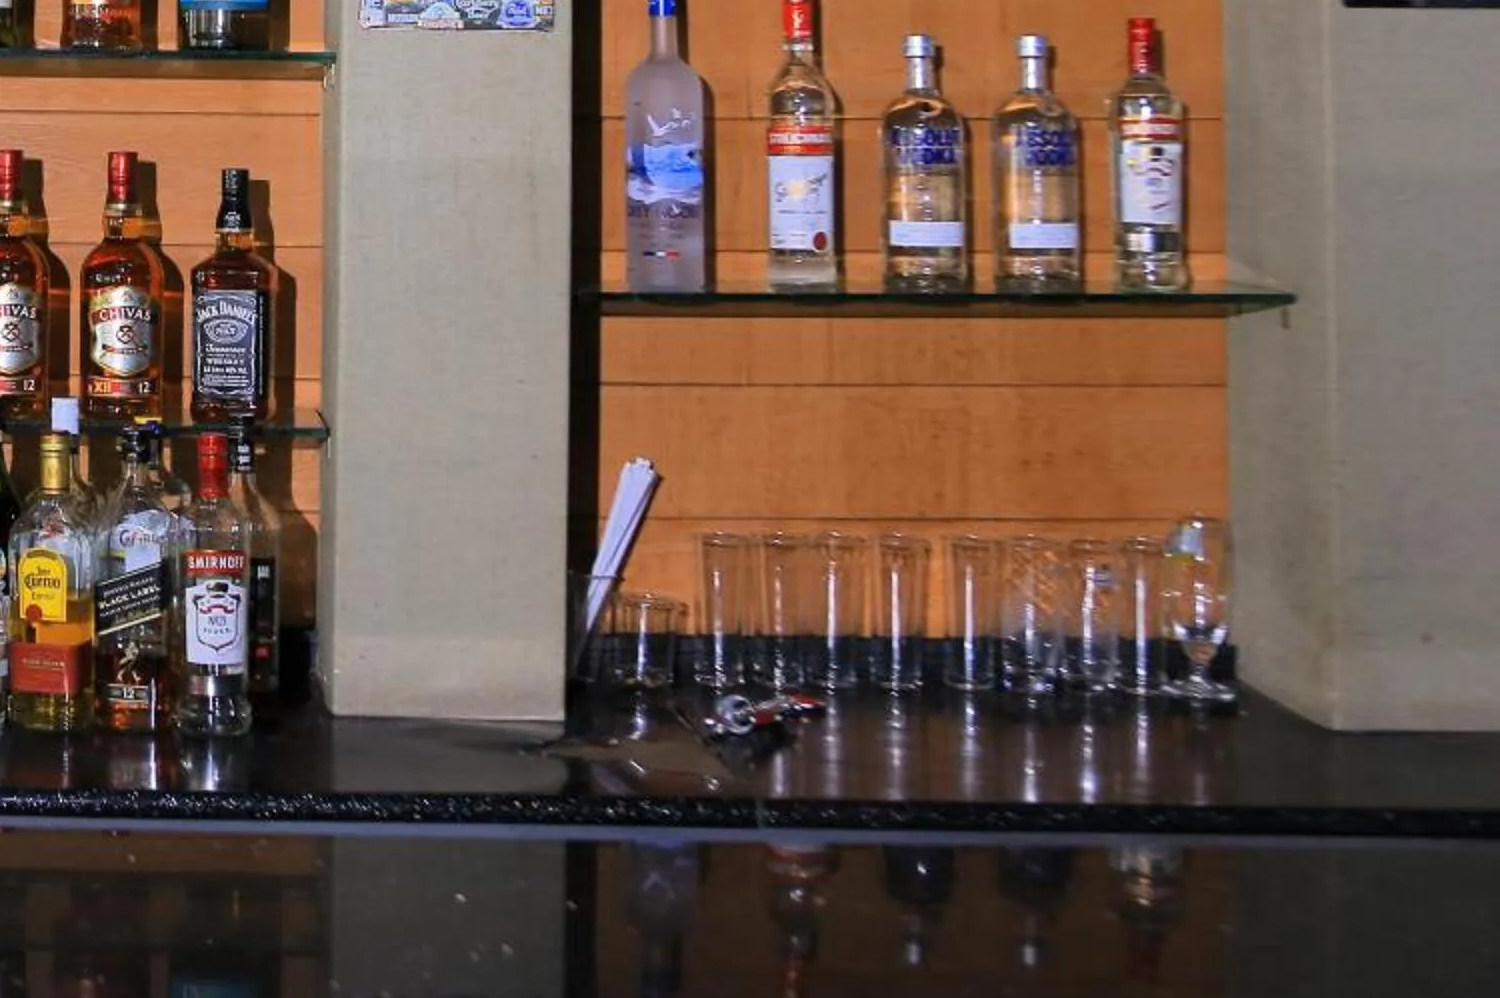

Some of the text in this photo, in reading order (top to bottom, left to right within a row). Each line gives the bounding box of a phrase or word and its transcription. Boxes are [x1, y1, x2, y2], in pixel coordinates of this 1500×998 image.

[98, 306, 152, 321] CHIVAS
[22, 378, 35, 391] 12
[138, 380, 150, 393] 12
[187, 555, 245, 569] SMIRNOFF
